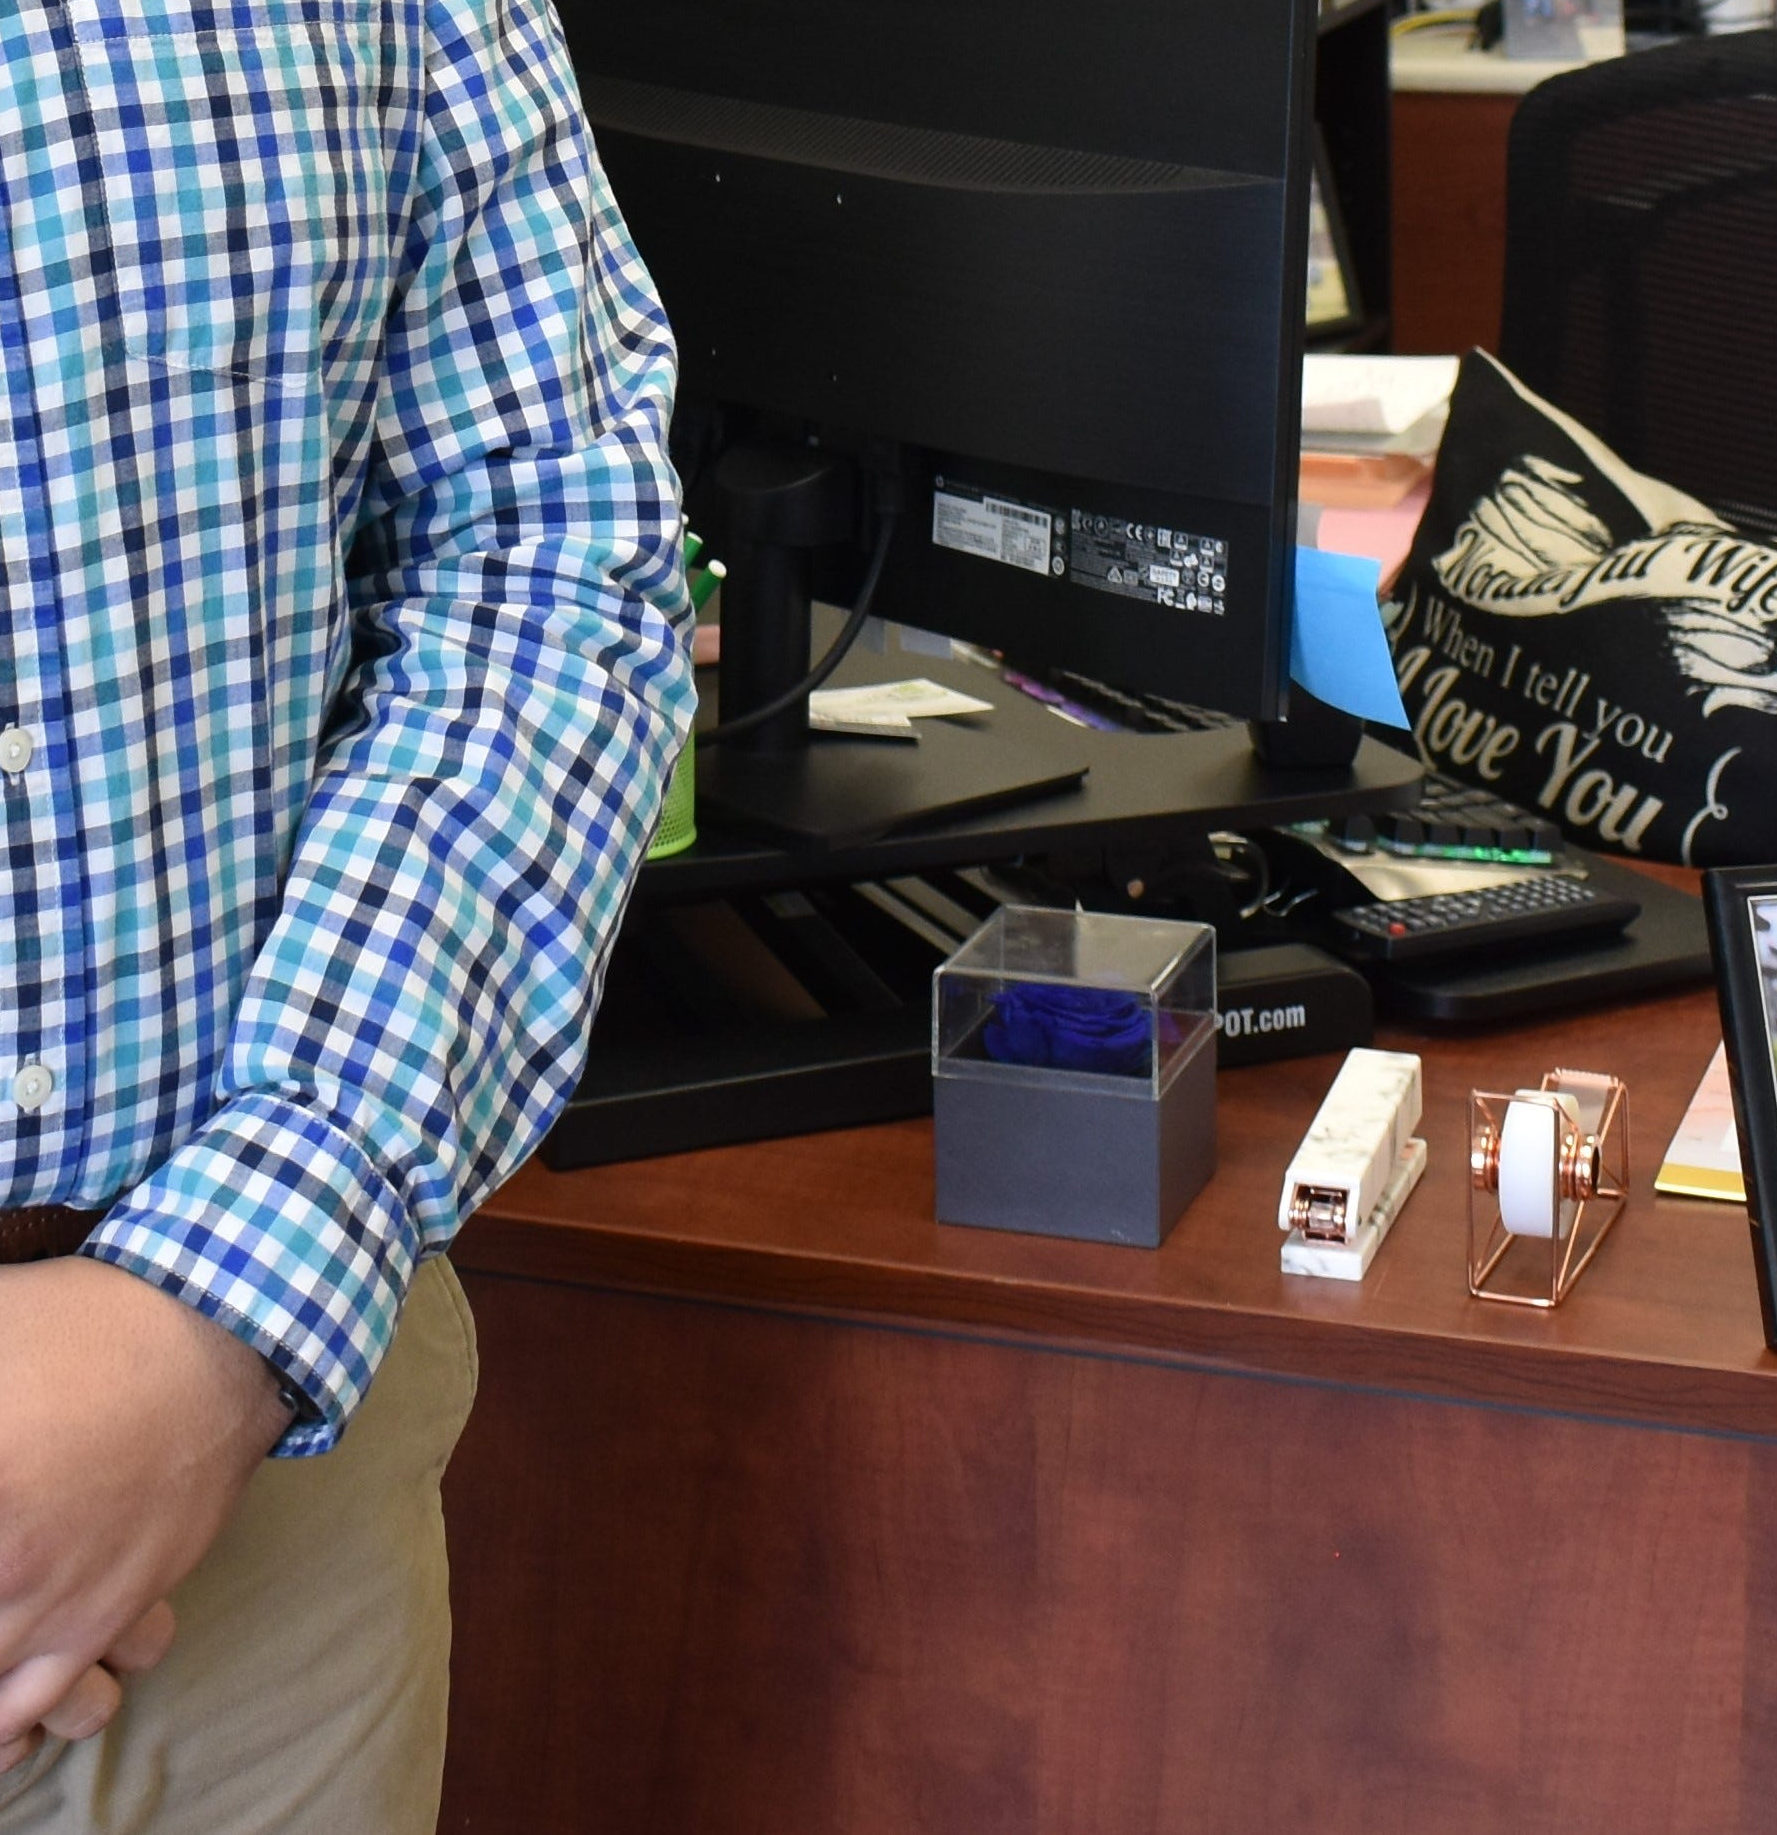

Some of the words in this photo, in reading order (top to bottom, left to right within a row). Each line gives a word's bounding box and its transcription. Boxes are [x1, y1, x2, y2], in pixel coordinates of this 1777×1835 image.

[1422, 595, 1497, 678] When
[1499, 644, 1522, 690] I
[1523, 660, 1591, 718] tell
[1583, 697, 1675, 764] you
[1533, 721, 1665, 853] You
